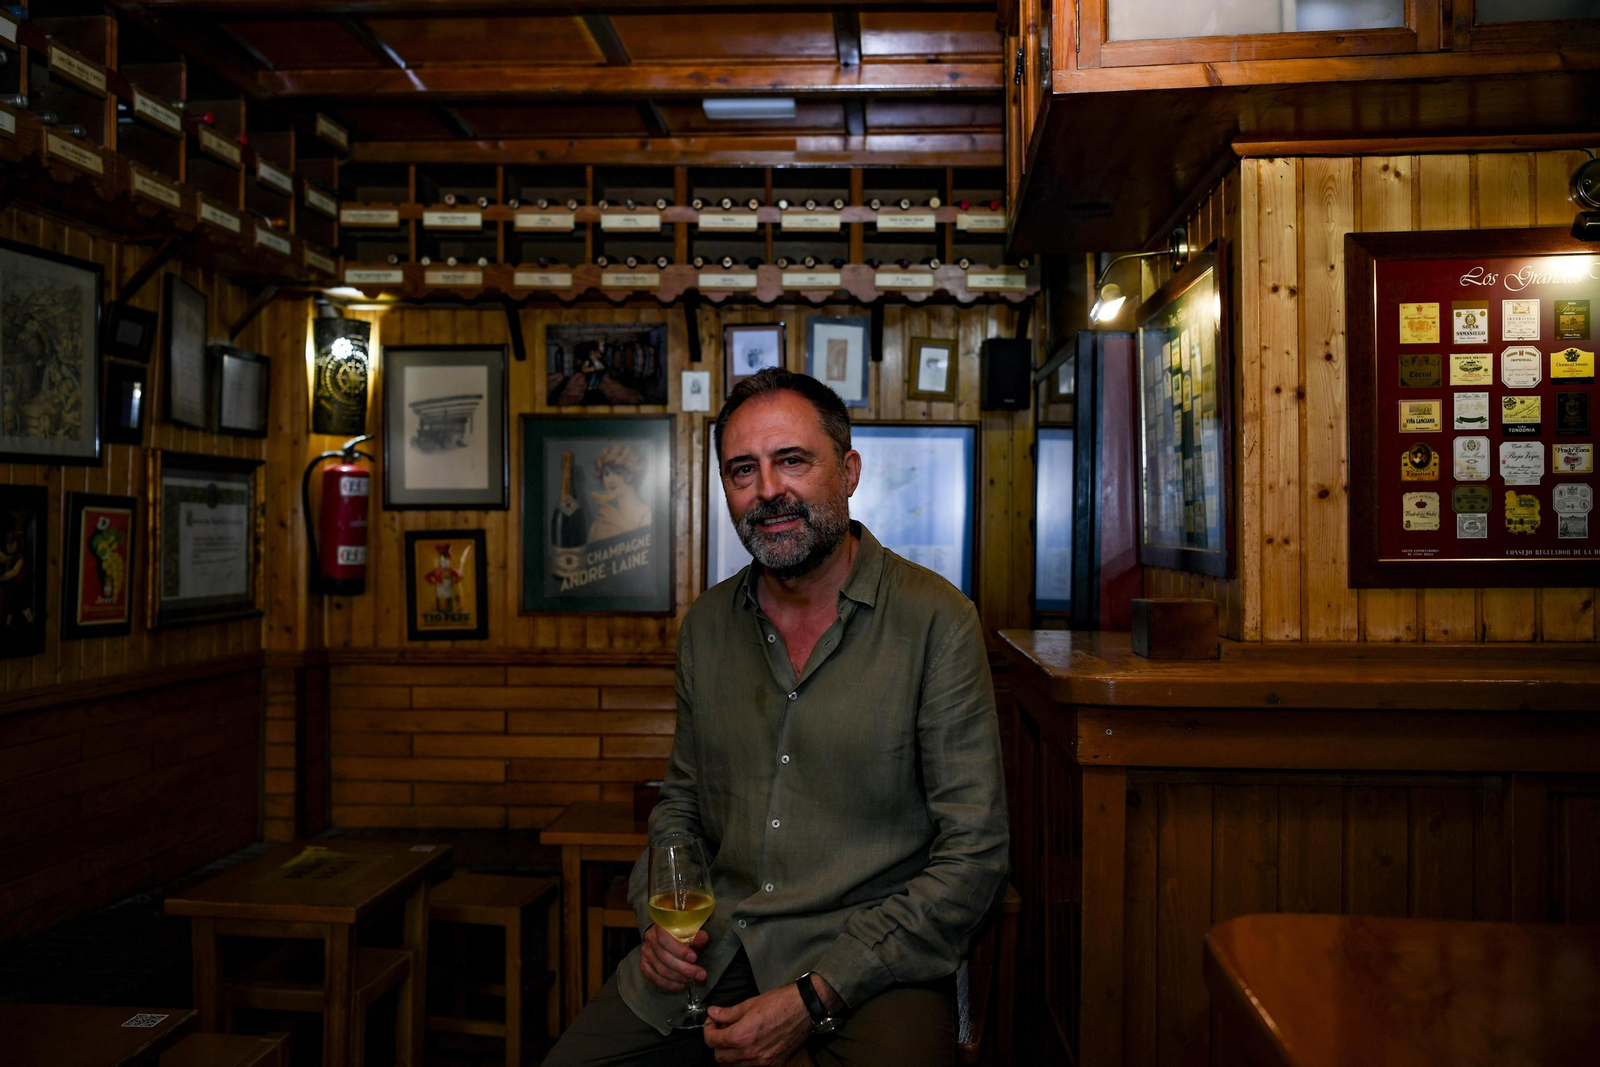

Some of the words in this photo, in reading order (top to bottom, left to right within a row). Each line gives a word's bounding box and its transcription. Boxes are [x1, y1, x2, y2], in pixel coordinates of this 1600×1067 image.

[1459, 266, 1499, 287] Los
[1507, 451, 1524, 462] Rioja
[586, 533, 651, 565] CHAMPAGNE
[444, 611, 470, 622] PEPE
